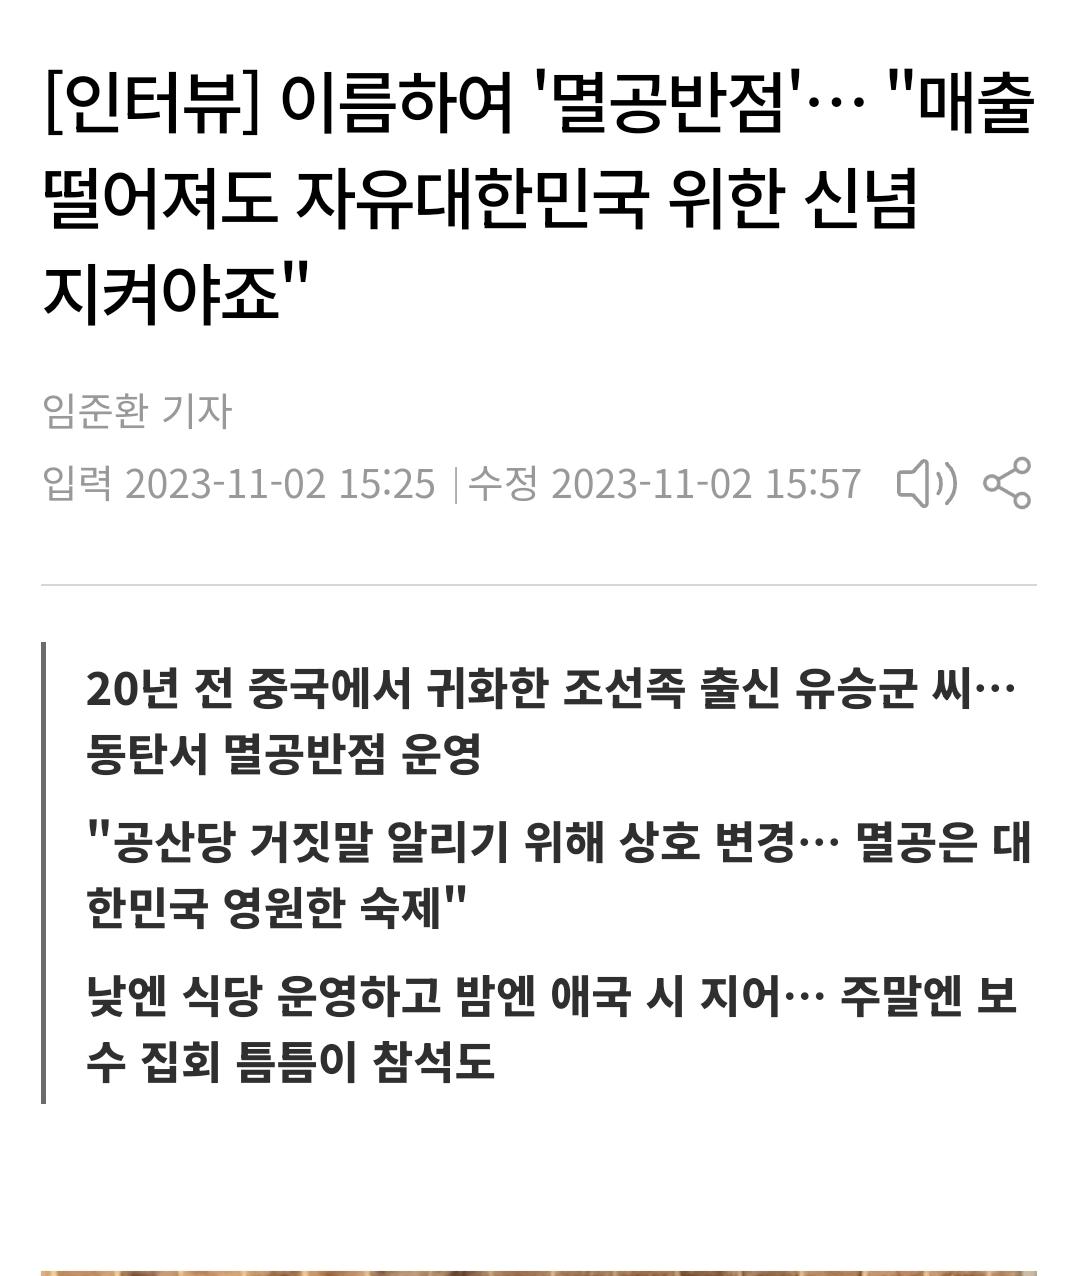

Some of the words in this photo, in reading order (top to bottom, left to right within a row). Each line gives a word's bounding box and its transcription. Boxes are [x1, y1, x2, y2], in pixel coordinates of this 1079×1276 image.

[48, 69, 258, 135] [인터뷰]
[282, 72, 510, 134] 이름하여
[889, 68, 1034, 134] "매출
[45, 168, 278, 230] 떨어져도
[297, 168, 650, 230] 자유대한민국
[669, 168, 786, 230] 위한
[805, 168, 915, 229] 신념
[44, 260, 307, 326] 지켜야죠"
[44, 393, 148, 429] 임준환
[164, 393, 232, 429] 기자
[44, 466, 109, 501] 입력
[127, 469, 325, 499] 2023-11-02
[341, 469, 434, 498] 15:25
[469, 466, 535, 501] 수정
[553, 469, 751, 498] 2023-11-02
[768, 469, 860, 498] 15:57
[87, 667, 177, 709] 20년
[195, 667, 232, 709] 전
[249, 667, 409, 710] 중국에서
[427, 667, 549, 709] 귀화한
[564, 667, 685, 709] 조선족
[701, 667, 779, 709] 출신
[796, 667, 918, 709] 유승군
[87, 733, 206, 776] 동탄서
[225, 733, 384, 775] 멸공반점
[402, 733, 479, 775] 운영
[89, 819, 236, 863] "공산당
[251, 821, 373, 863] 거짓말
[388, 821, 506, 863] 알리기
[525, 821, 603, 863] 위해
[619, 821, 700, 863] 상호
[858, 821, 977, 863] 멸공은
[994, 821, 1030, 863] 대
[87, 887, 208, 929] 한민국
[224, 887, 346, 929] 영원한
[361, 885, 465, 929] 숙제"
[183, 975, 263, 1017] 식당
[278, 975, 441, 1018] 운영하고
[457, 975, 535, 1017] 밤엔
[552, 975, 631, 1017] 애국
[647, 975, 682, 1017] 시
[841, 975, 961, 1017] 주말엔
[978, 978, 1016, 1013] 보
[87, 1042, 125, 1083] 수
[142, 1041, 218, 1083] 집회
[237, 1041, 355, 1083] 틈틈이
[373, 1041, 494, 1083] 참석도
